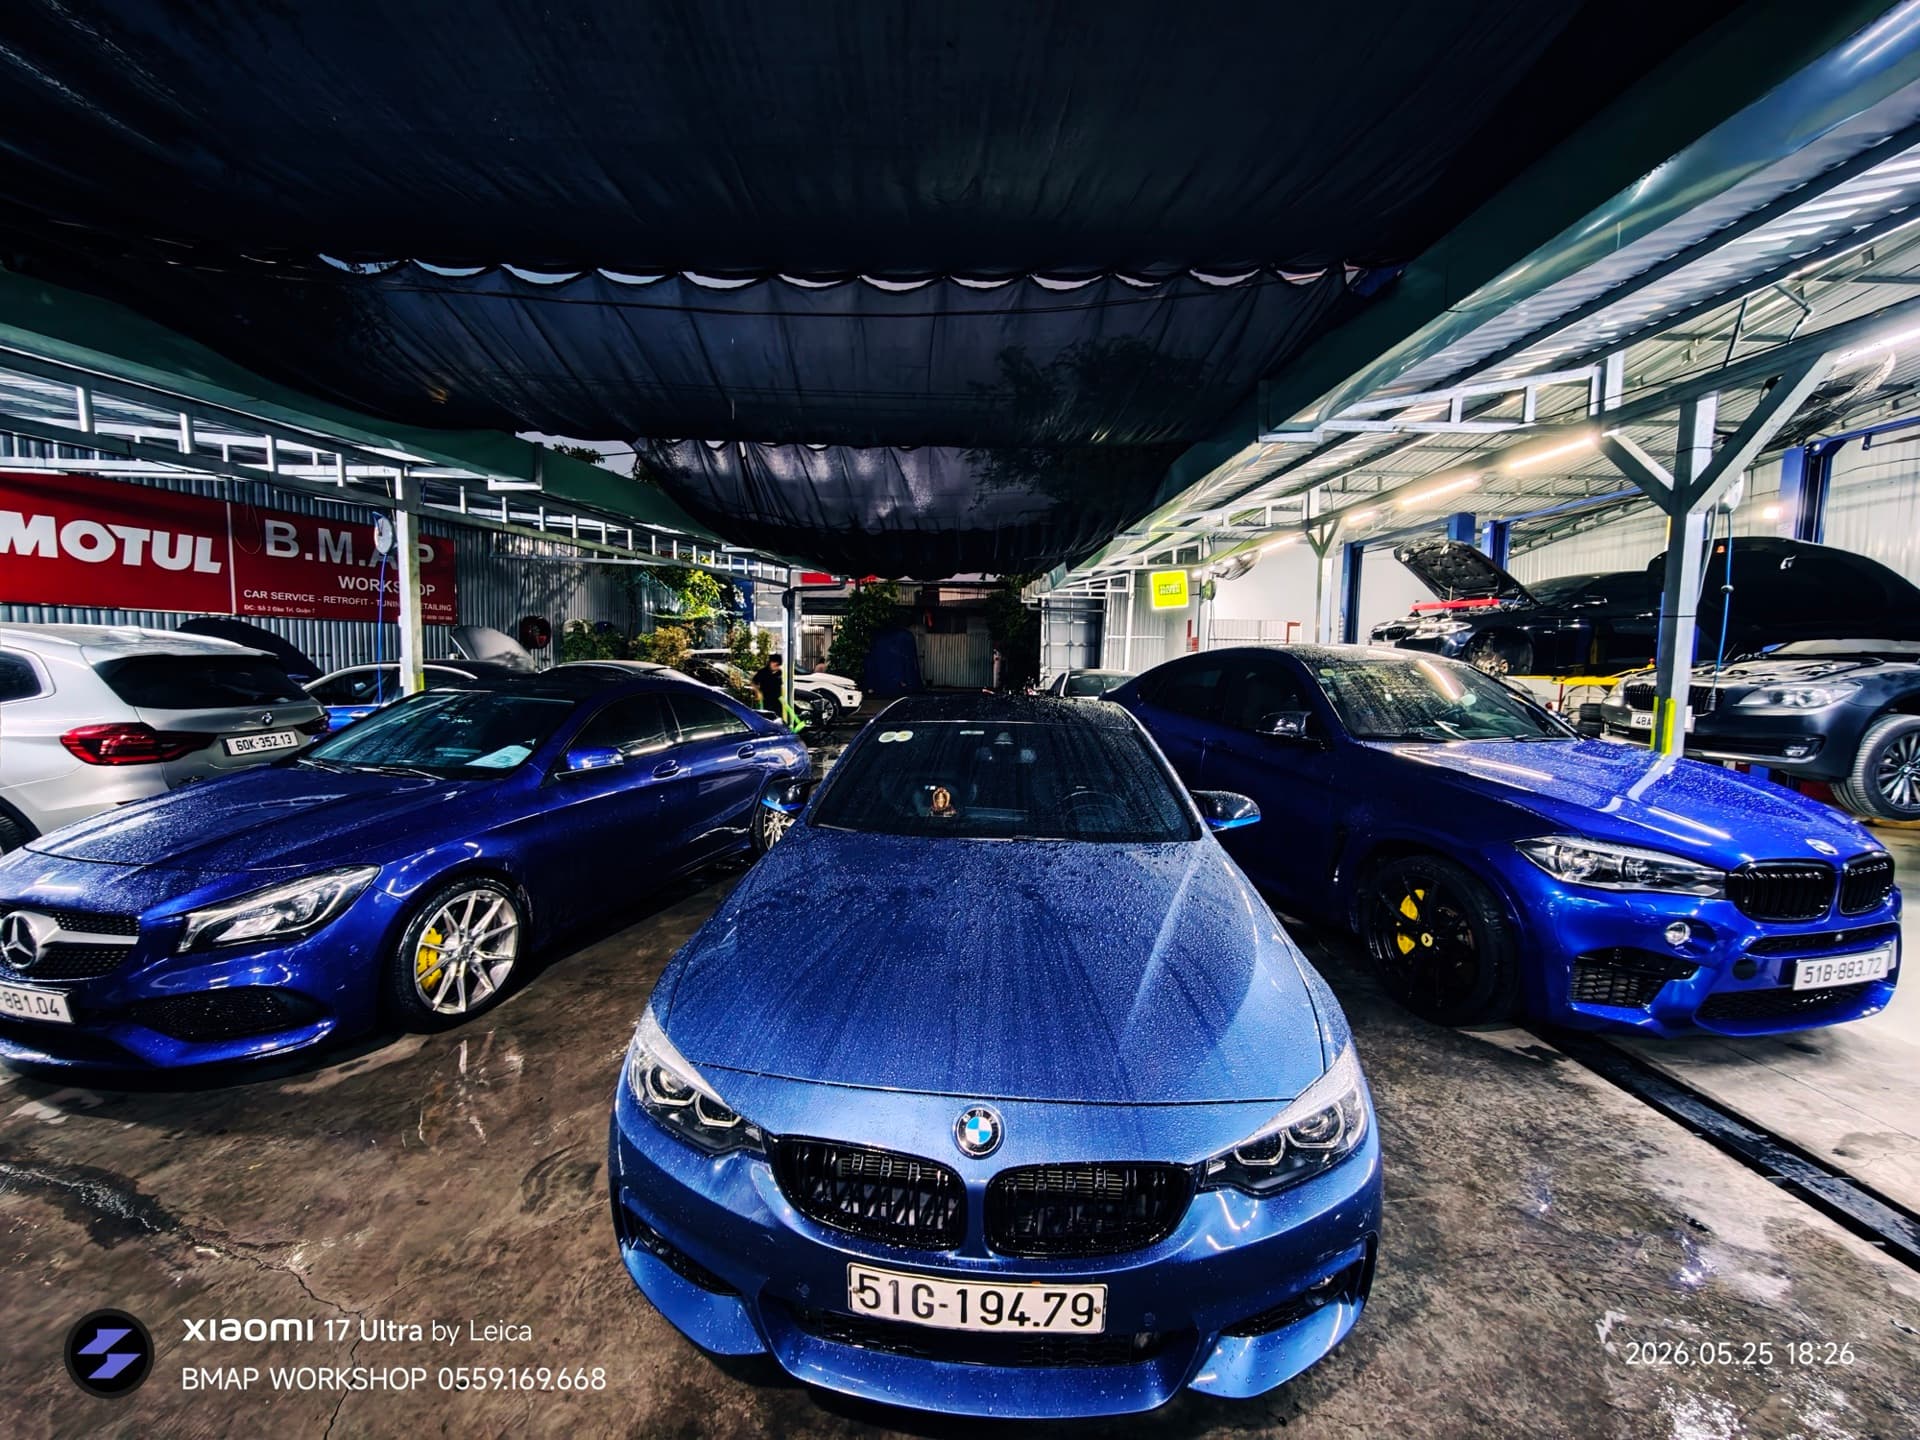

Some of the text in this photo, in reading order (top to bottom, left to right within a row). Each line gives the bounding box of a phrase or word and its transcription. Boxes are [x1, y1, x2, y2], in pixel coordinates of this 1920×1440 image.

[0, 510, 222, 574] MOTUL
[243, 589, 268, 599] CAR
[270, 591, 316, 602] SERVICE
[323, 596, 368, 606] RETROFIT
[235, 734, 293, 751] 60K-352.13
[1803, 957, 1882, 984] 51B-883.72
[857, 1273, 1096, 1328] 51G-194.79
